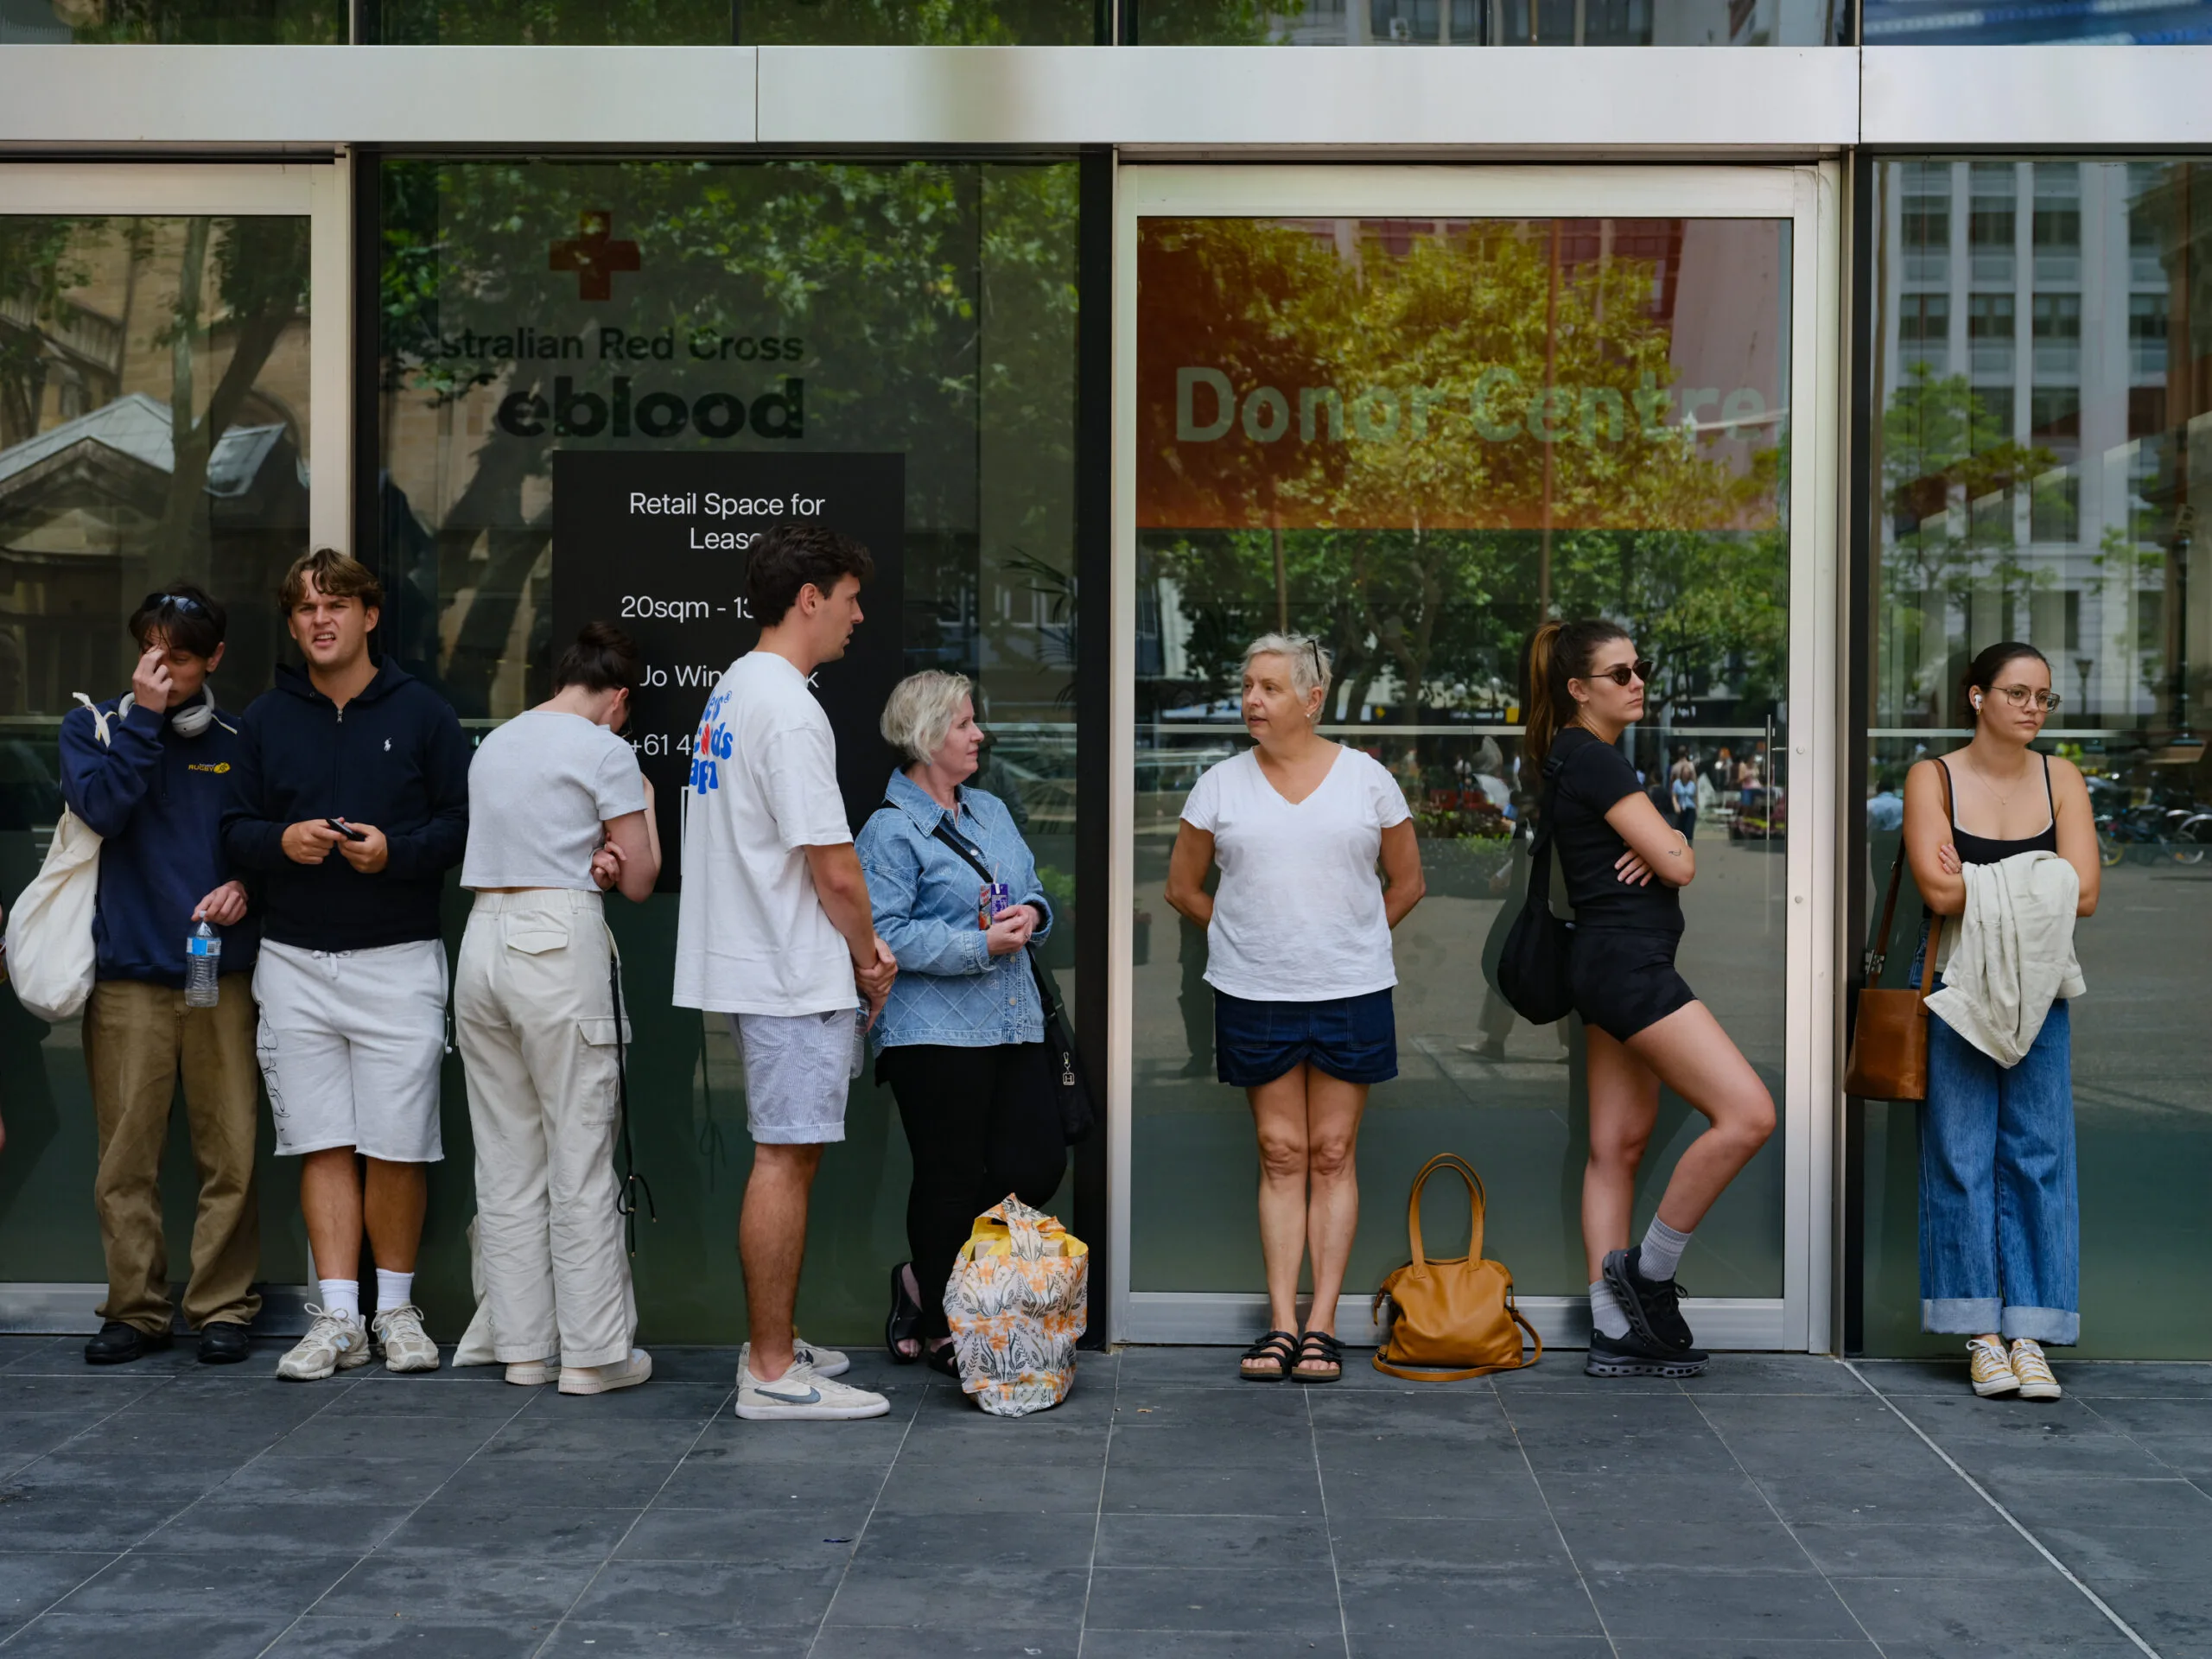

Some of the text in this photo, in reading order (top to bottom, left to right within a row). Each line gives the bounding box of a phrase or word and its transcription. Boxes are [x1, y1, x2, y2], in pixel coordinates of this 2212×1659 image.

[442, 327, 804, 361] stralian Red Cross
[467, 374, 804, 439] eblood
[1175, 365, 1767, 443] Donor Centre
[630, 492, 825, 520] Retail Space for
[620, 595, 709, 624] 20sqm
[639, 665, 668, 688] Jo
[629, 734, 668, 756] +61
